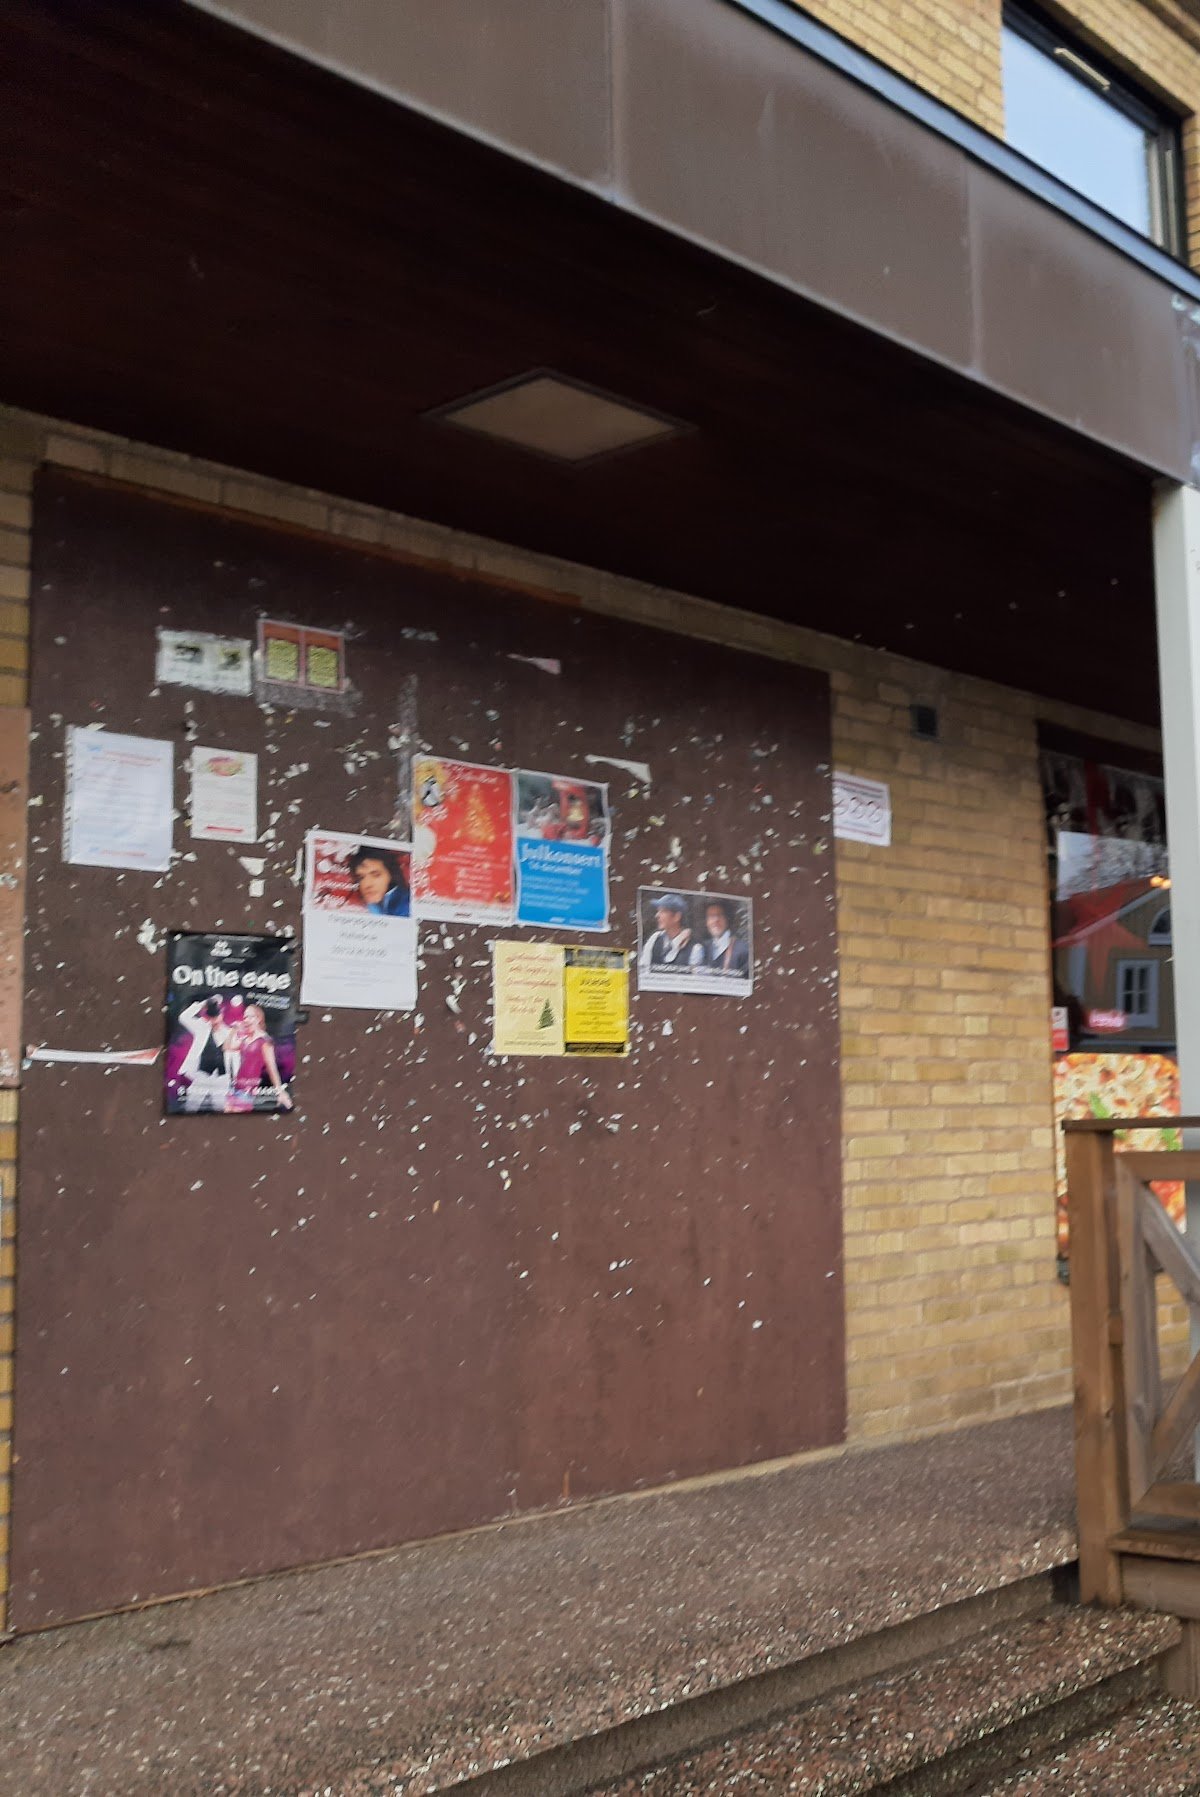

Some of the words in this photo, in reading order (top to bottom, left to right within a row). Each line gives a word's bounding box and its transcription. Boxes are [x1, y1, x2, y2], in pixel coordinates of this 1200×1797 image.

[172, 965, 204, 987] On
[204, 965, 240, 988] the
[241, 971, 292, 993] edge
